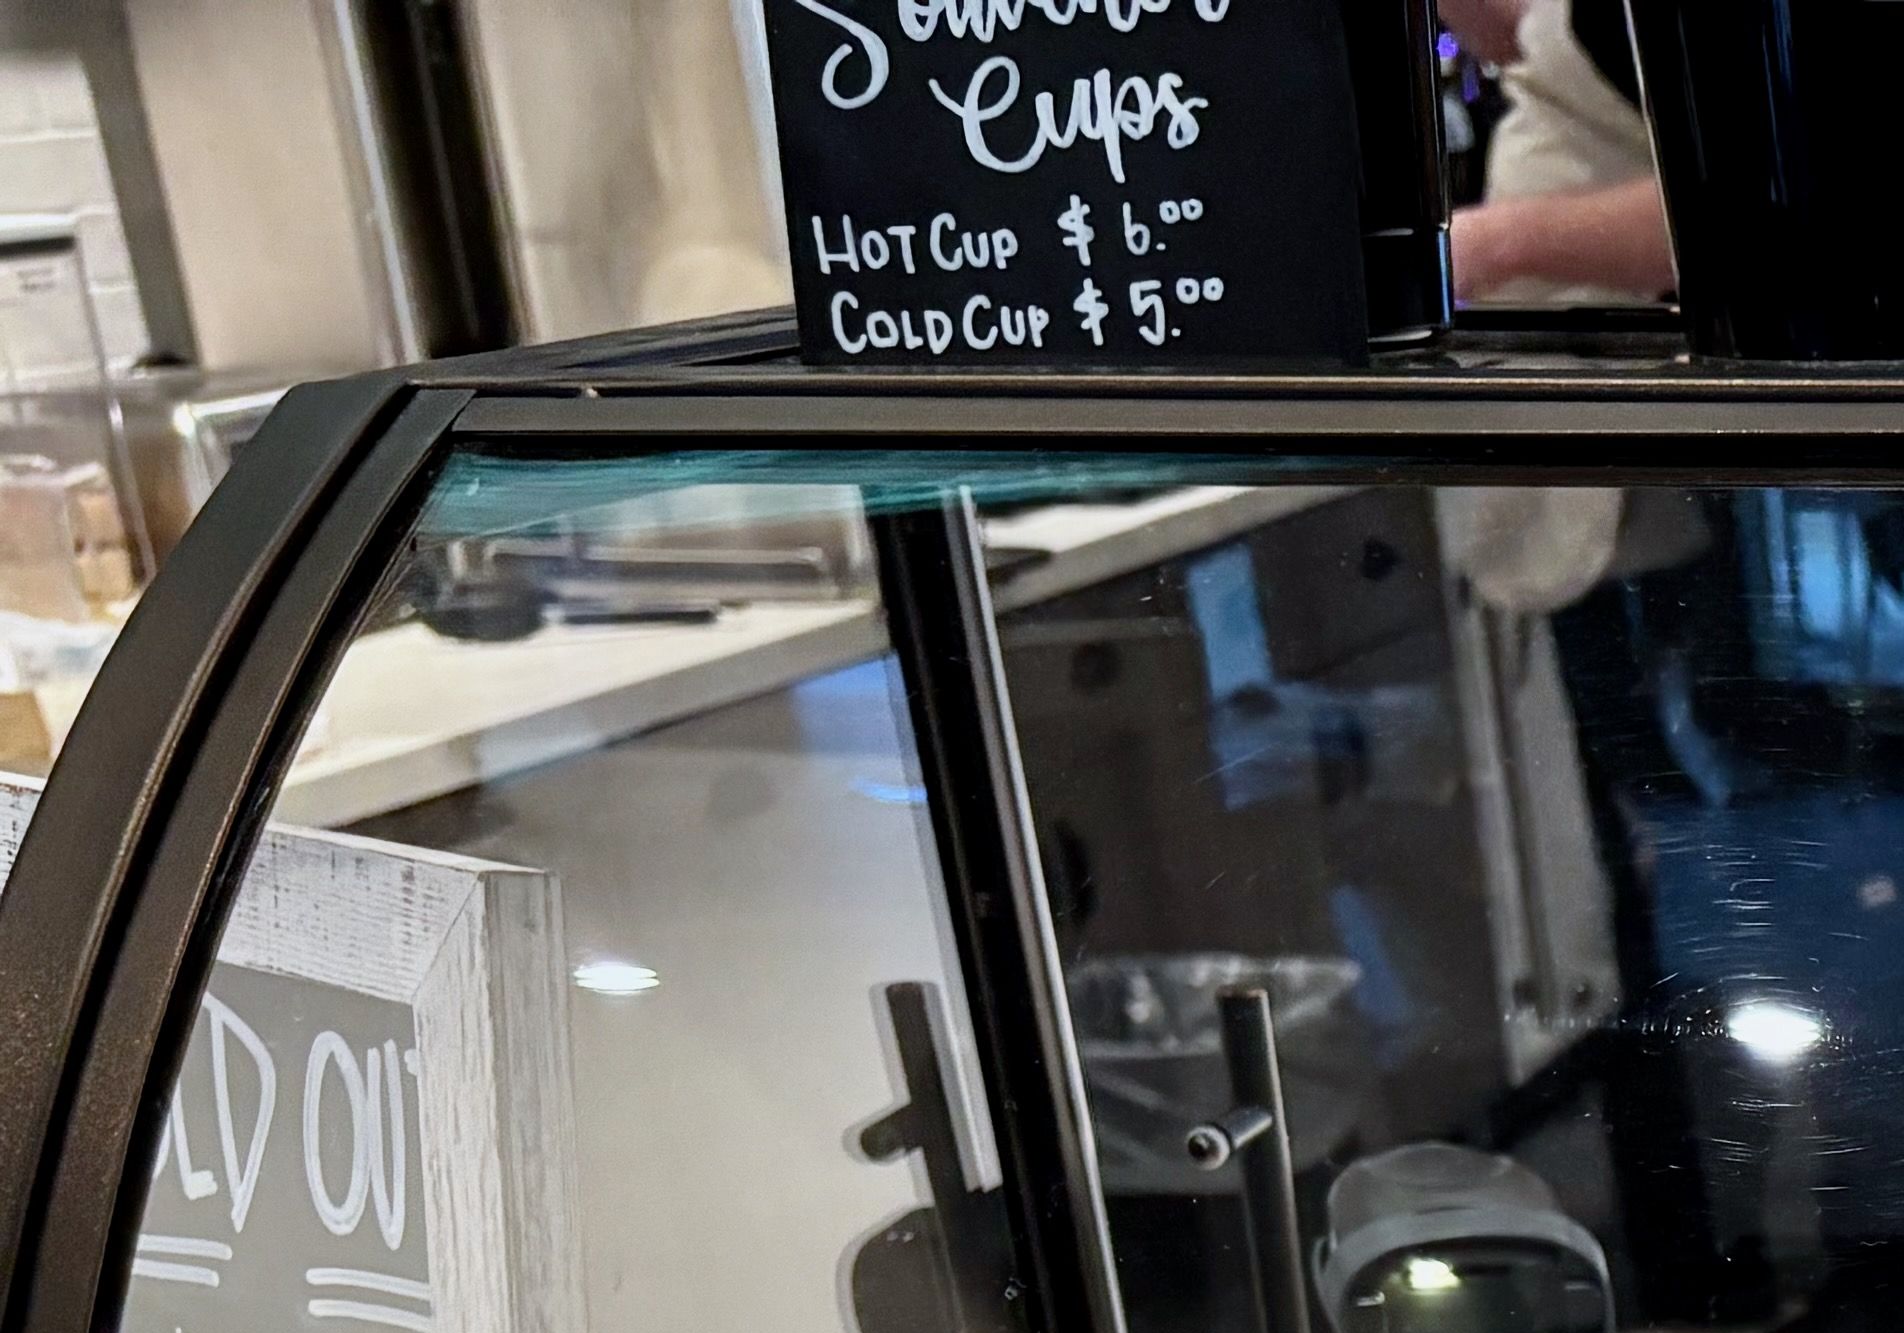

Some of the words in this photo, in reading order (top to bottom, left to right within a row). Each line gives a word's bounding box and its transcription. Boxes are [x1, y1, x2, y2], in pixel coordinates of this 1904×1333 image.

[929, 56, 1208, 183] Cups
[1057, 195, 1091, 266] $
[1122, 198, 1204, 255] 6.00
[831, 292, 952, 355] COLD
[963, 294, 1049, 350] CUP
[1073, 278, 1109, 346] $
[1130, 276, 1225, 346] 5.00
[303, 1030, 420, 1250] OU
